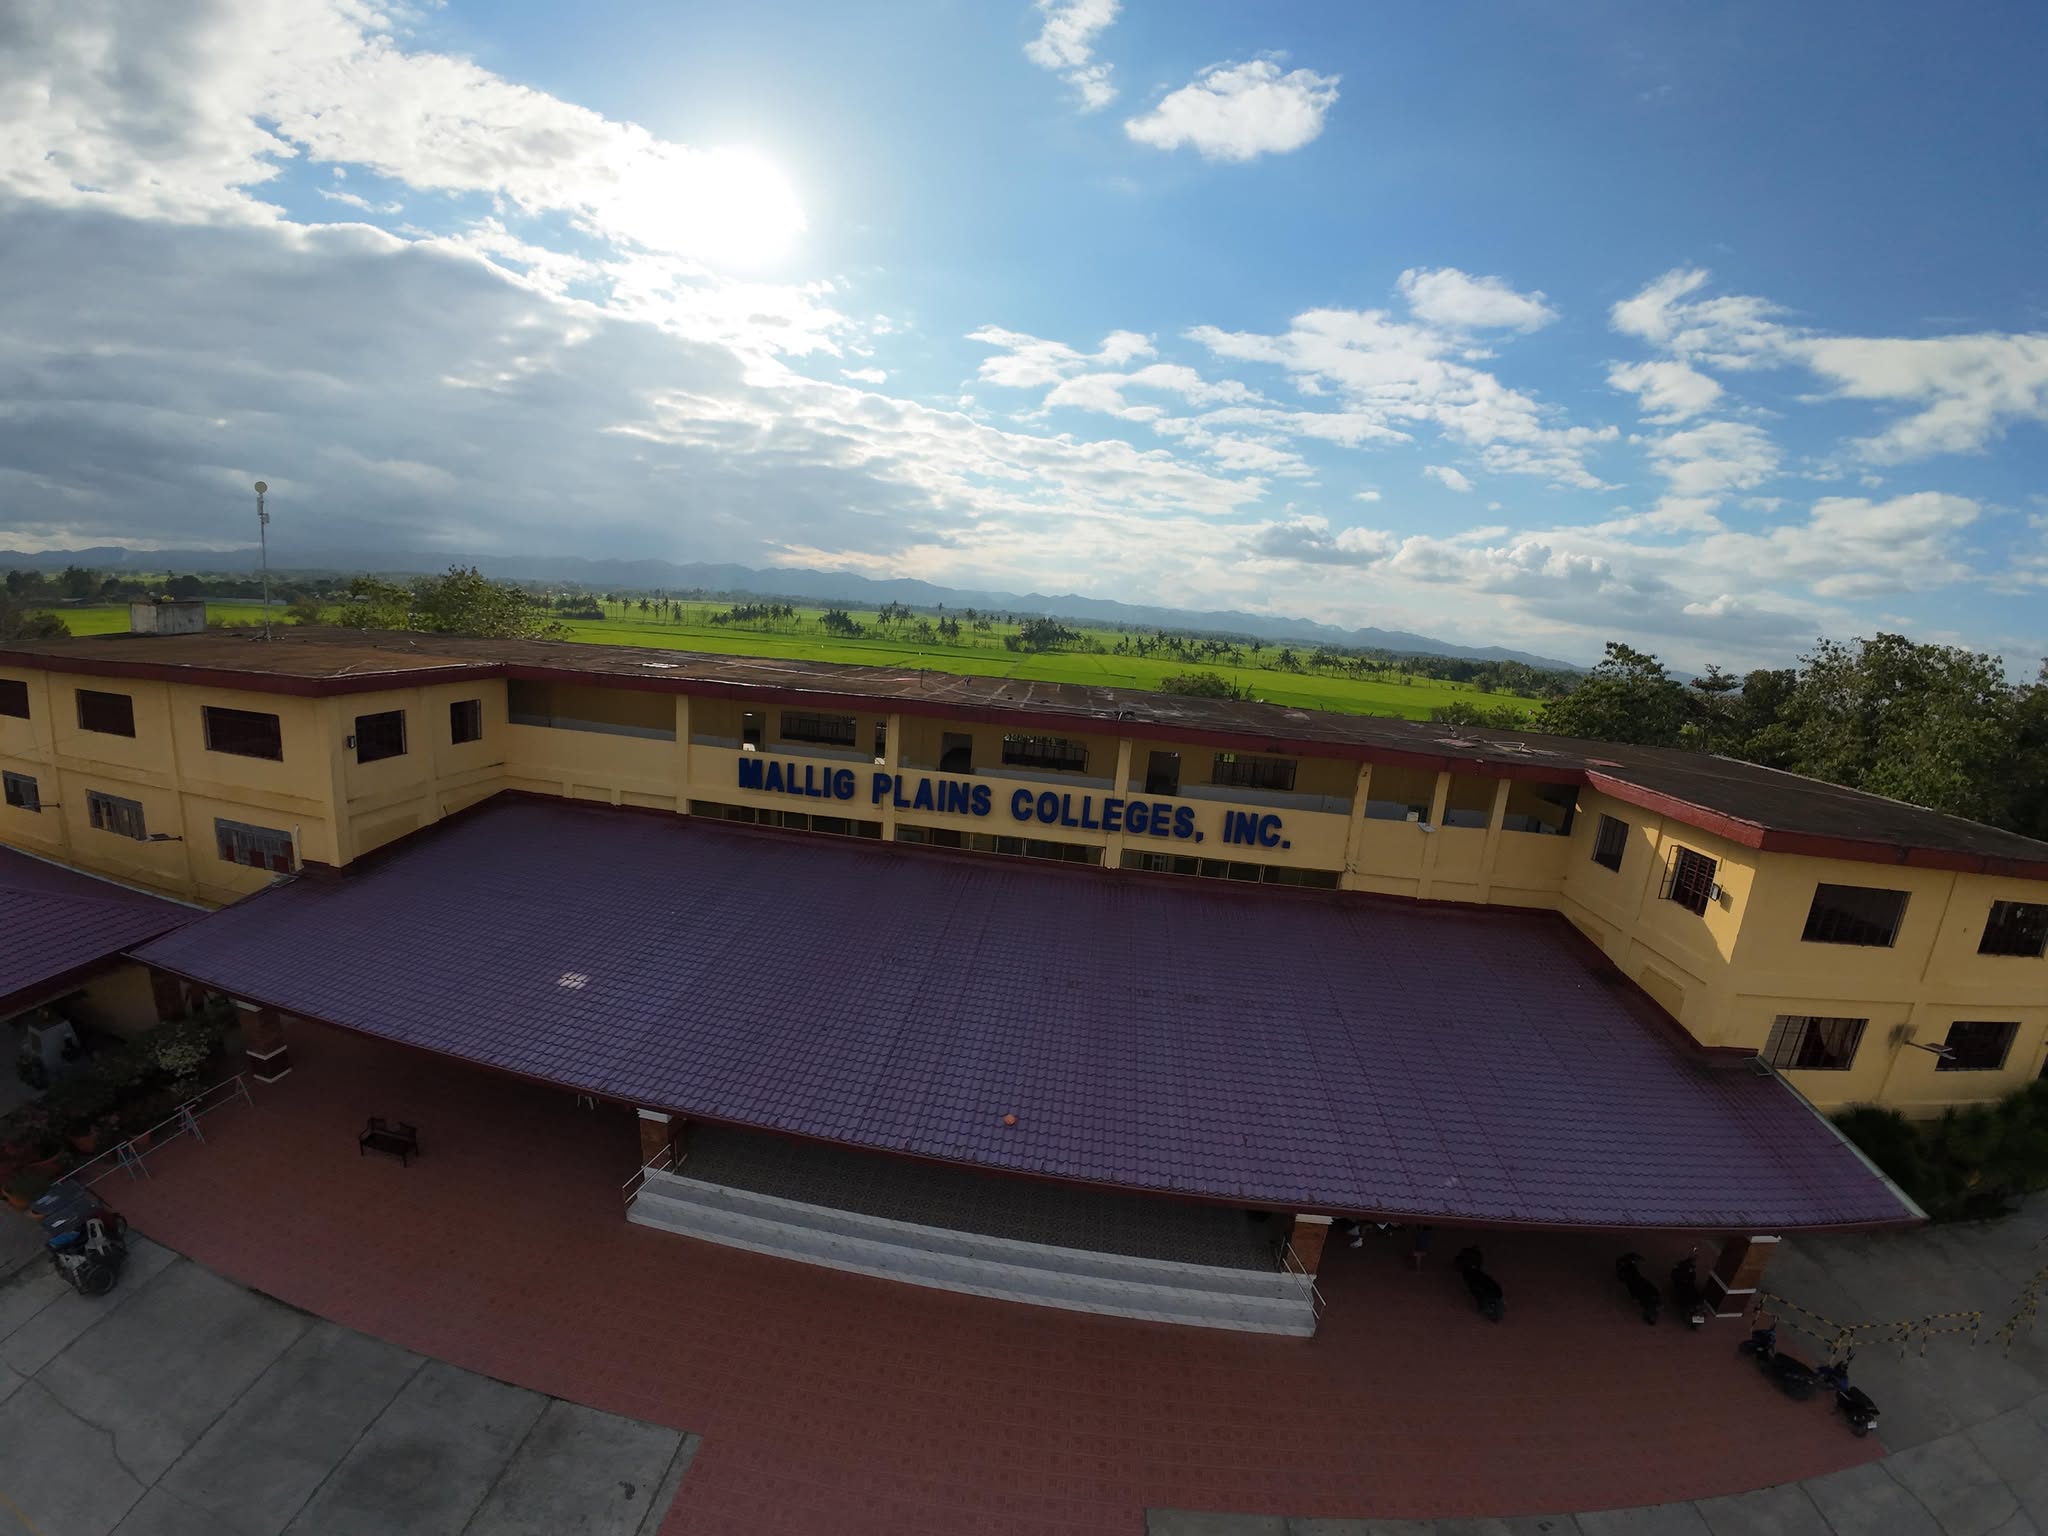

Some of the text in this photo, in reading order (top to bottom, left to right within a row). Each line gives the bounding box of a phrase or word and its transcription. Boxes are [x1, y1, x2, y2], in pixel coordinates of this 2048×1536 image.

[738, 758, 1291, 850] MALLIG PLAINS COLLEGES, INC.
